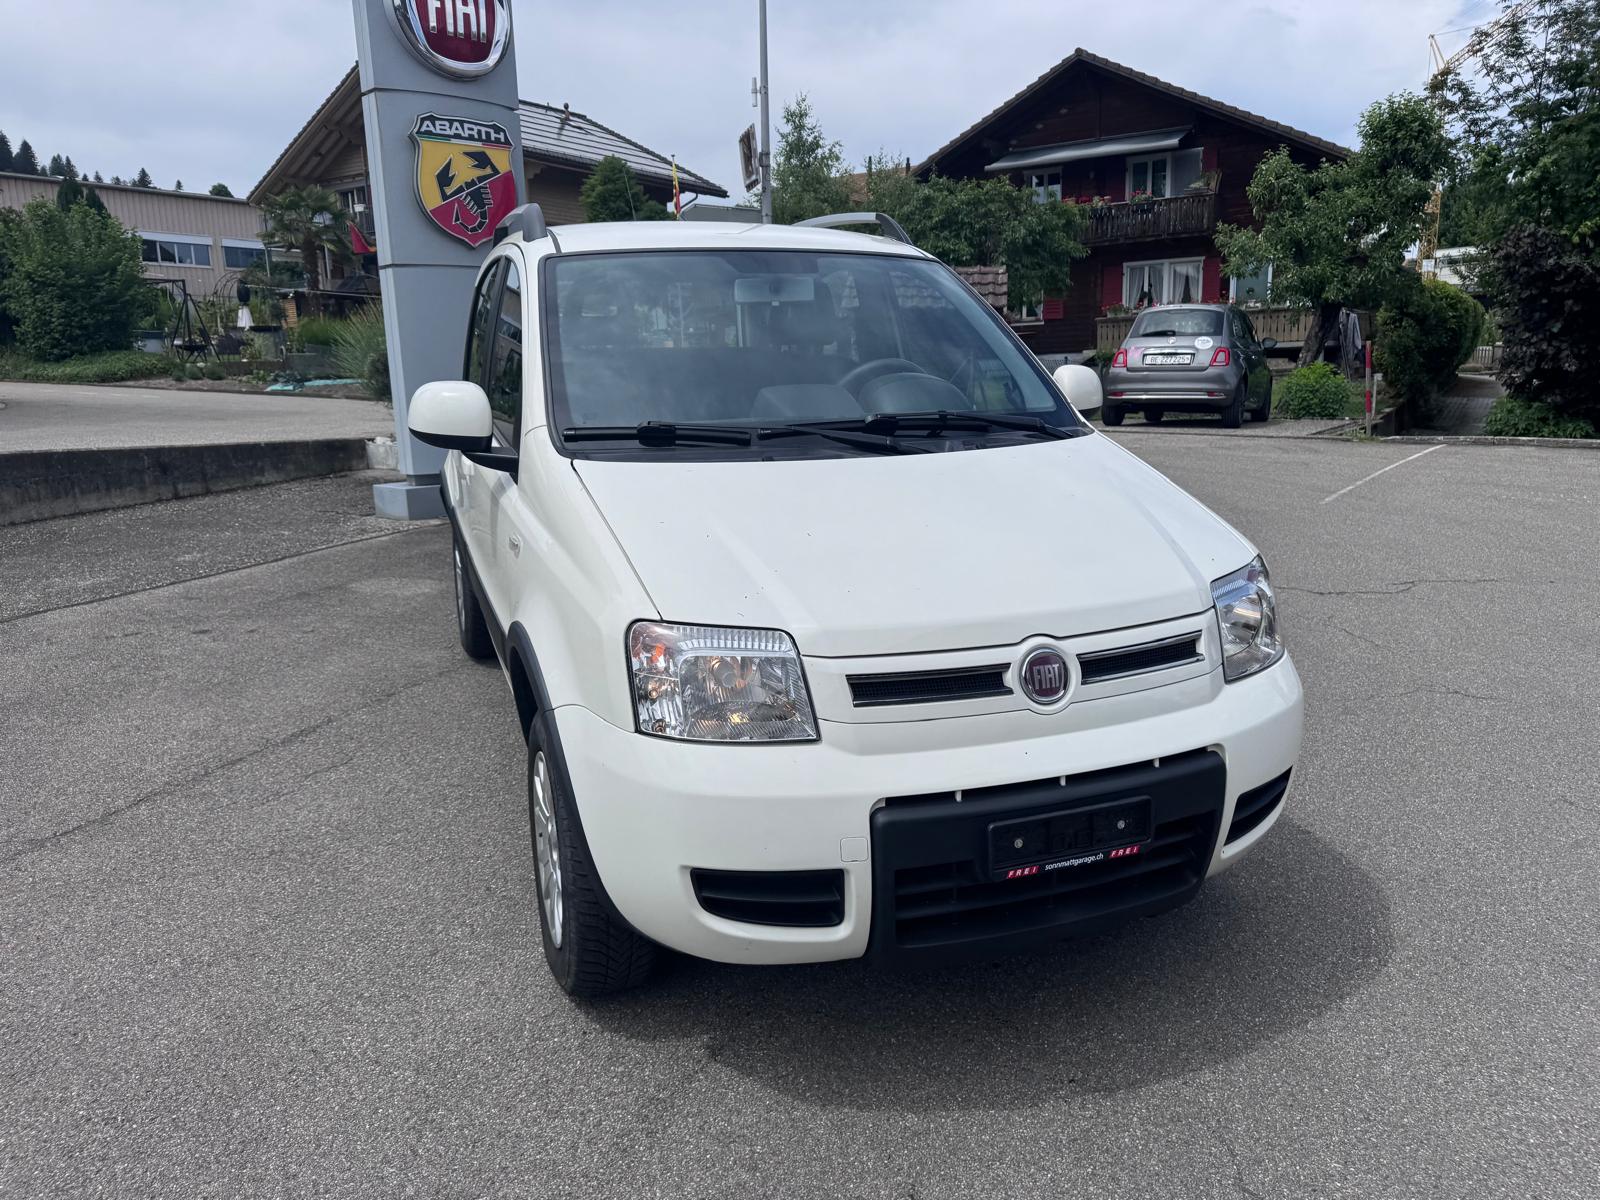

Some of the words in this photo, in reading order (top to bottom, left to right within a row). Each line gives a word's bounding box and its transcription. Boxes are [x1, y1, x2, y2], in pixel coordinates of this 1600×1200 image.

[427, 0, 487, 43] FIAT
[420, 120, 505, 142] ABARTH
[1033, 664, 1059, 690] FIAT
[1008, 866, 1038, 878] FREI
[1044, 852, 1104, 871] sonnmattgarage.ch
[1111, 846, 1138, 858] FREI
